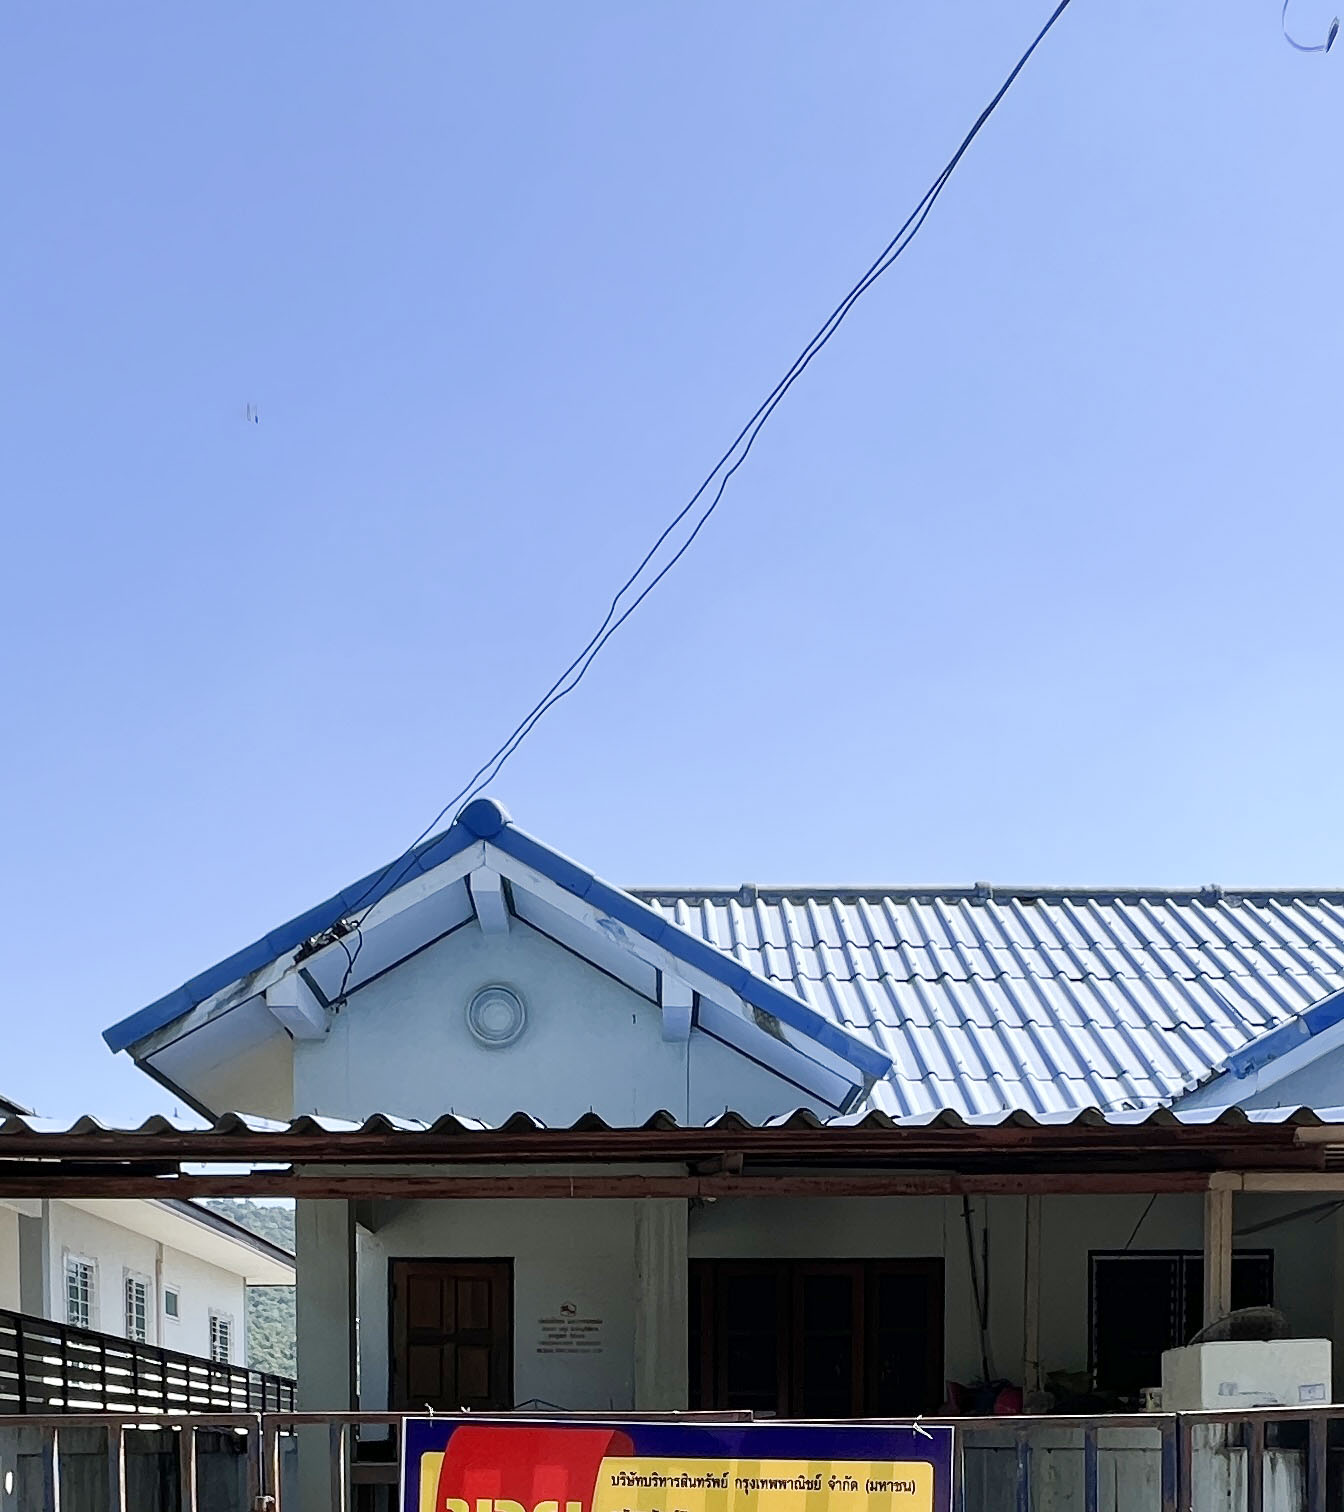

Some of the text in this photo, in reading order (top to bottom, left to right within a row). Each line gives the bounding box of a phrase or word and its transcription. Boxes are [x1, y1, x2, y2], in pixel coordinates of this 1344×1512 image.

[611, 1471, 916, 1495] บริษัทบริหารสินทรัพย์ กรุงเทพพาณิชย์ จำกัด (มหาชน)
